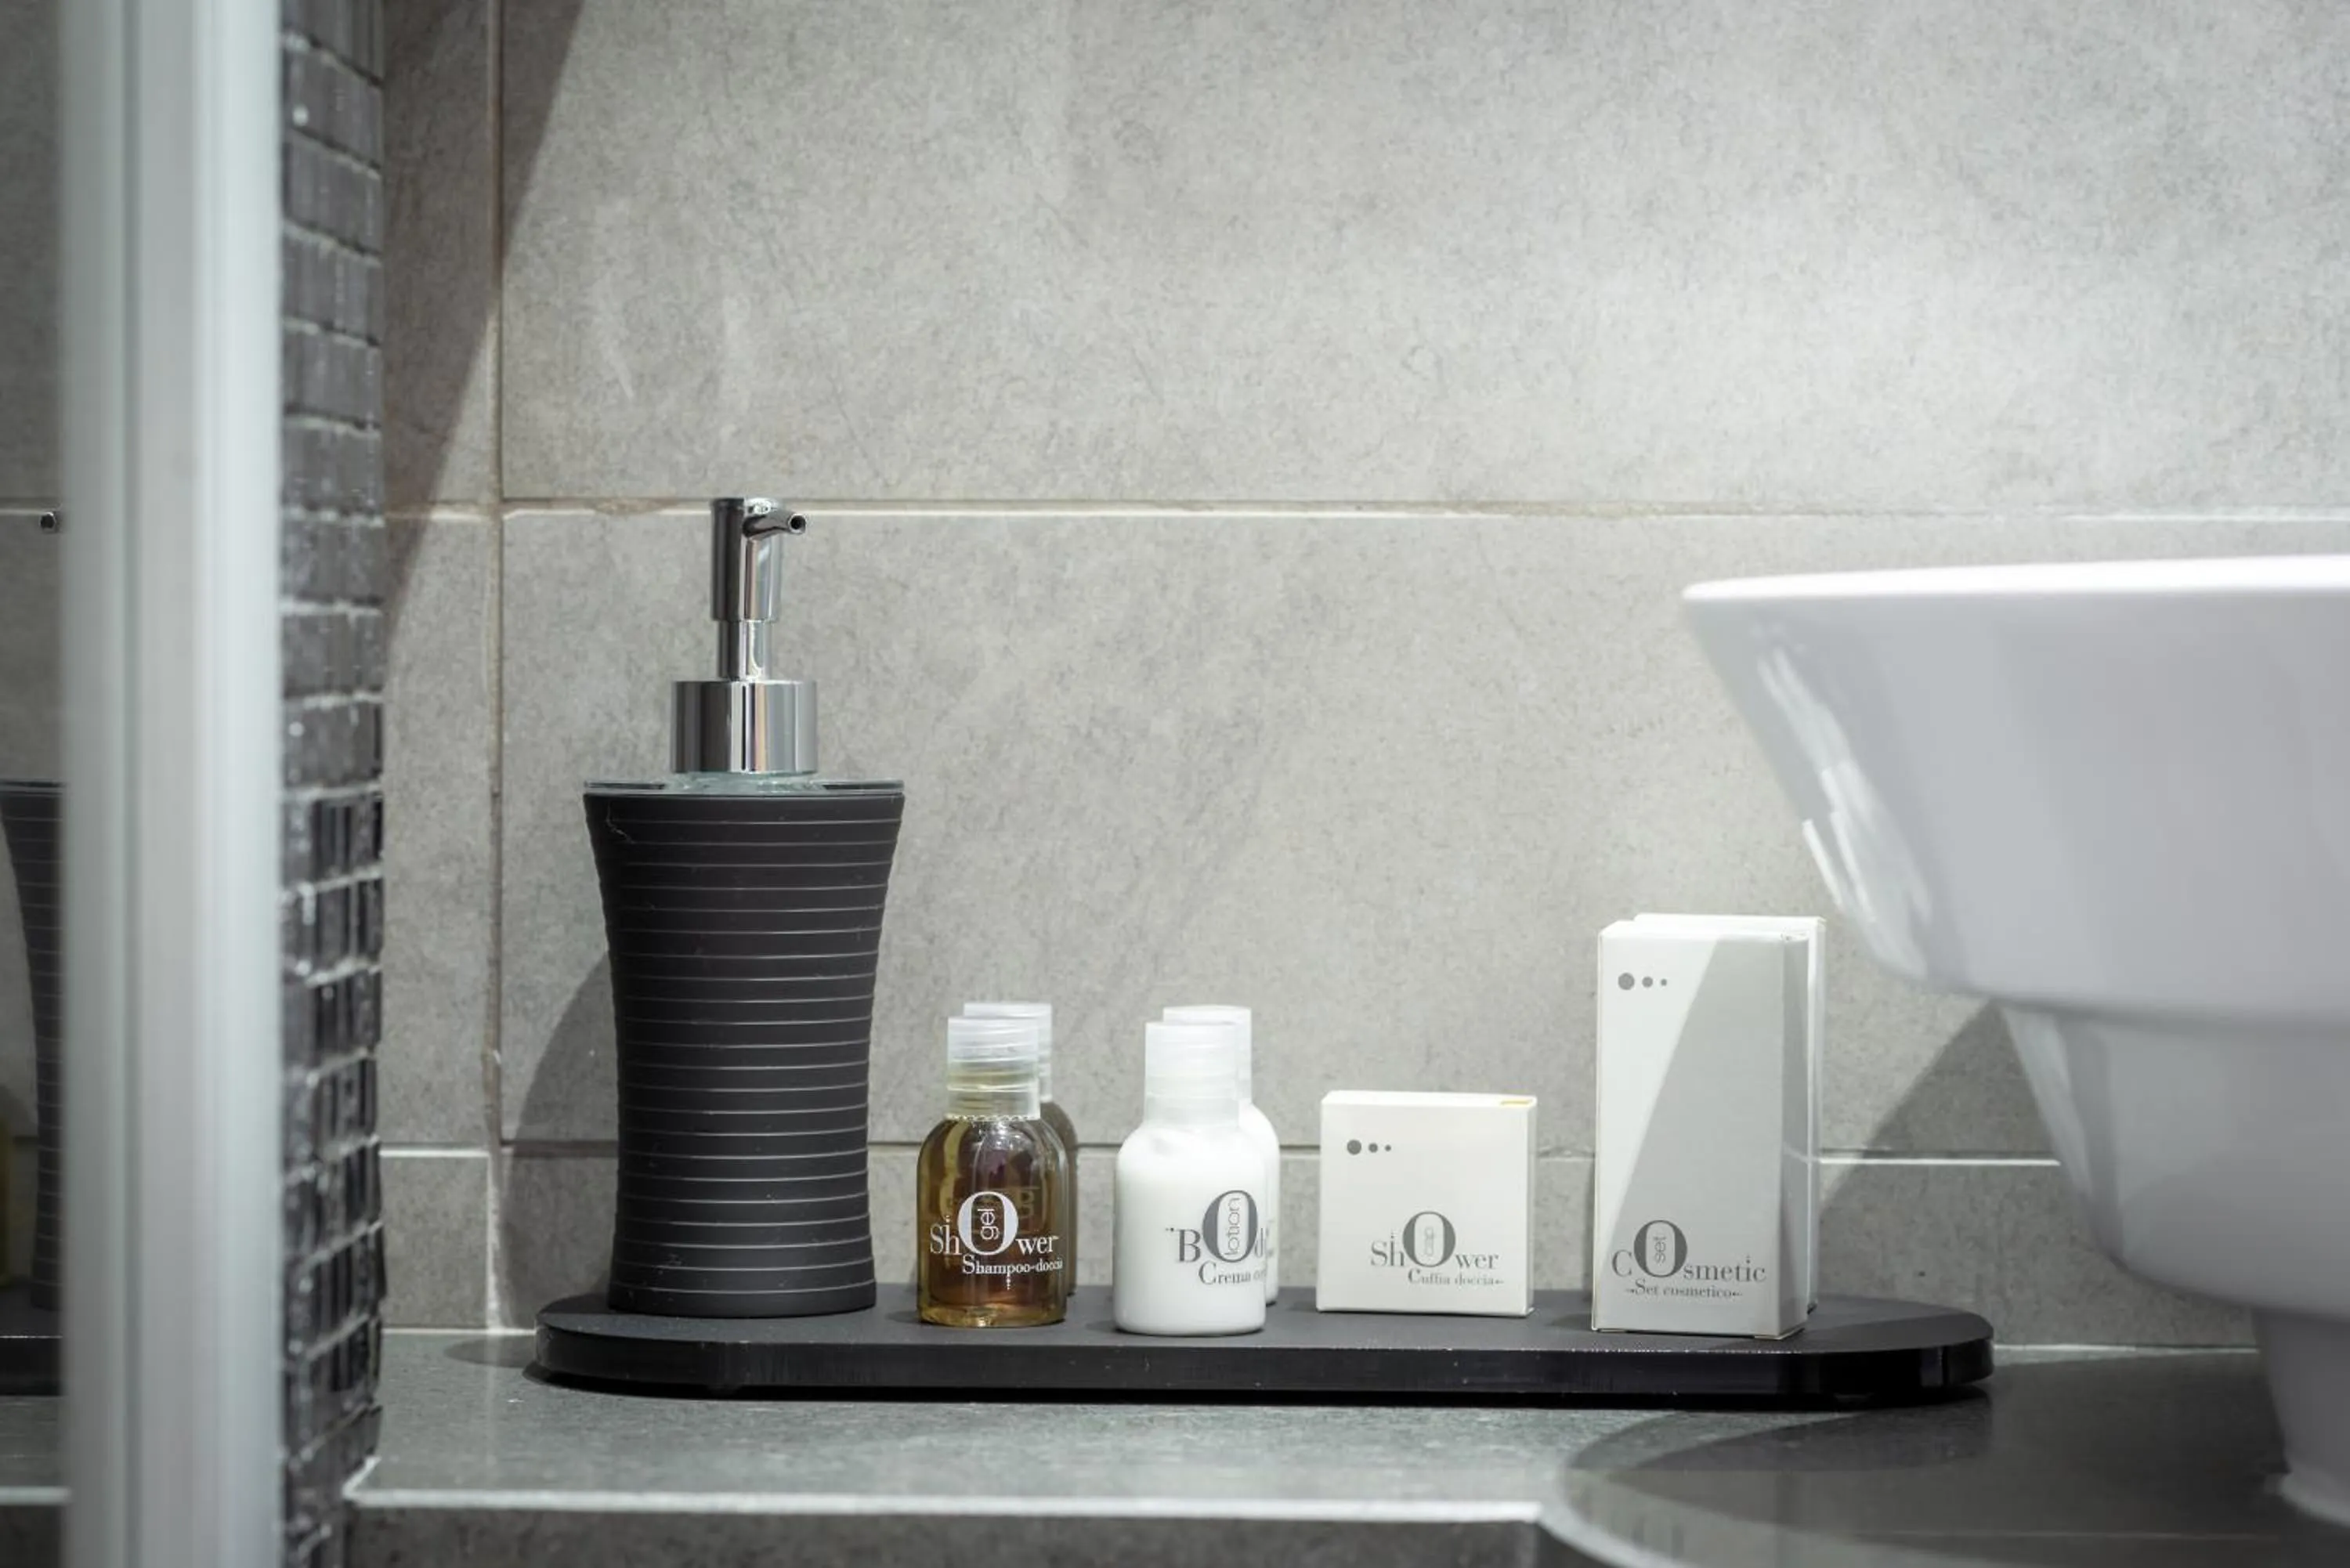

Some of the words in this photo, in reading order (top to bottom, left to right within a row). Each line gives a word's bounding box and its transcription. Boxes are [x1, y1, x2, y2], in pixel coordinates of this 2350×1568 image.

[929, 1190, 1058, 1255] ShOwer
[977, 1208, 1000, 1241] gel
[1177, 1189, 1264, 1263] BOd
[1224, 1198, 1242, 1256] lotion
[1371, 1211, 1499, 1269] ShOwer
[1198, 1259, 1252, 1285] Crema
[1611, 1219, 1767, 1282] COsmetic
[1653, 1236, 1666, 1264] set
[1408, 1267, 1450, 1285] Cuffia
[1454, 1271, 1495, 1286] doccia
[1634, 1277, 1658, 1296] Set
[1662, 1284, 1733, 1299] cosmetico
